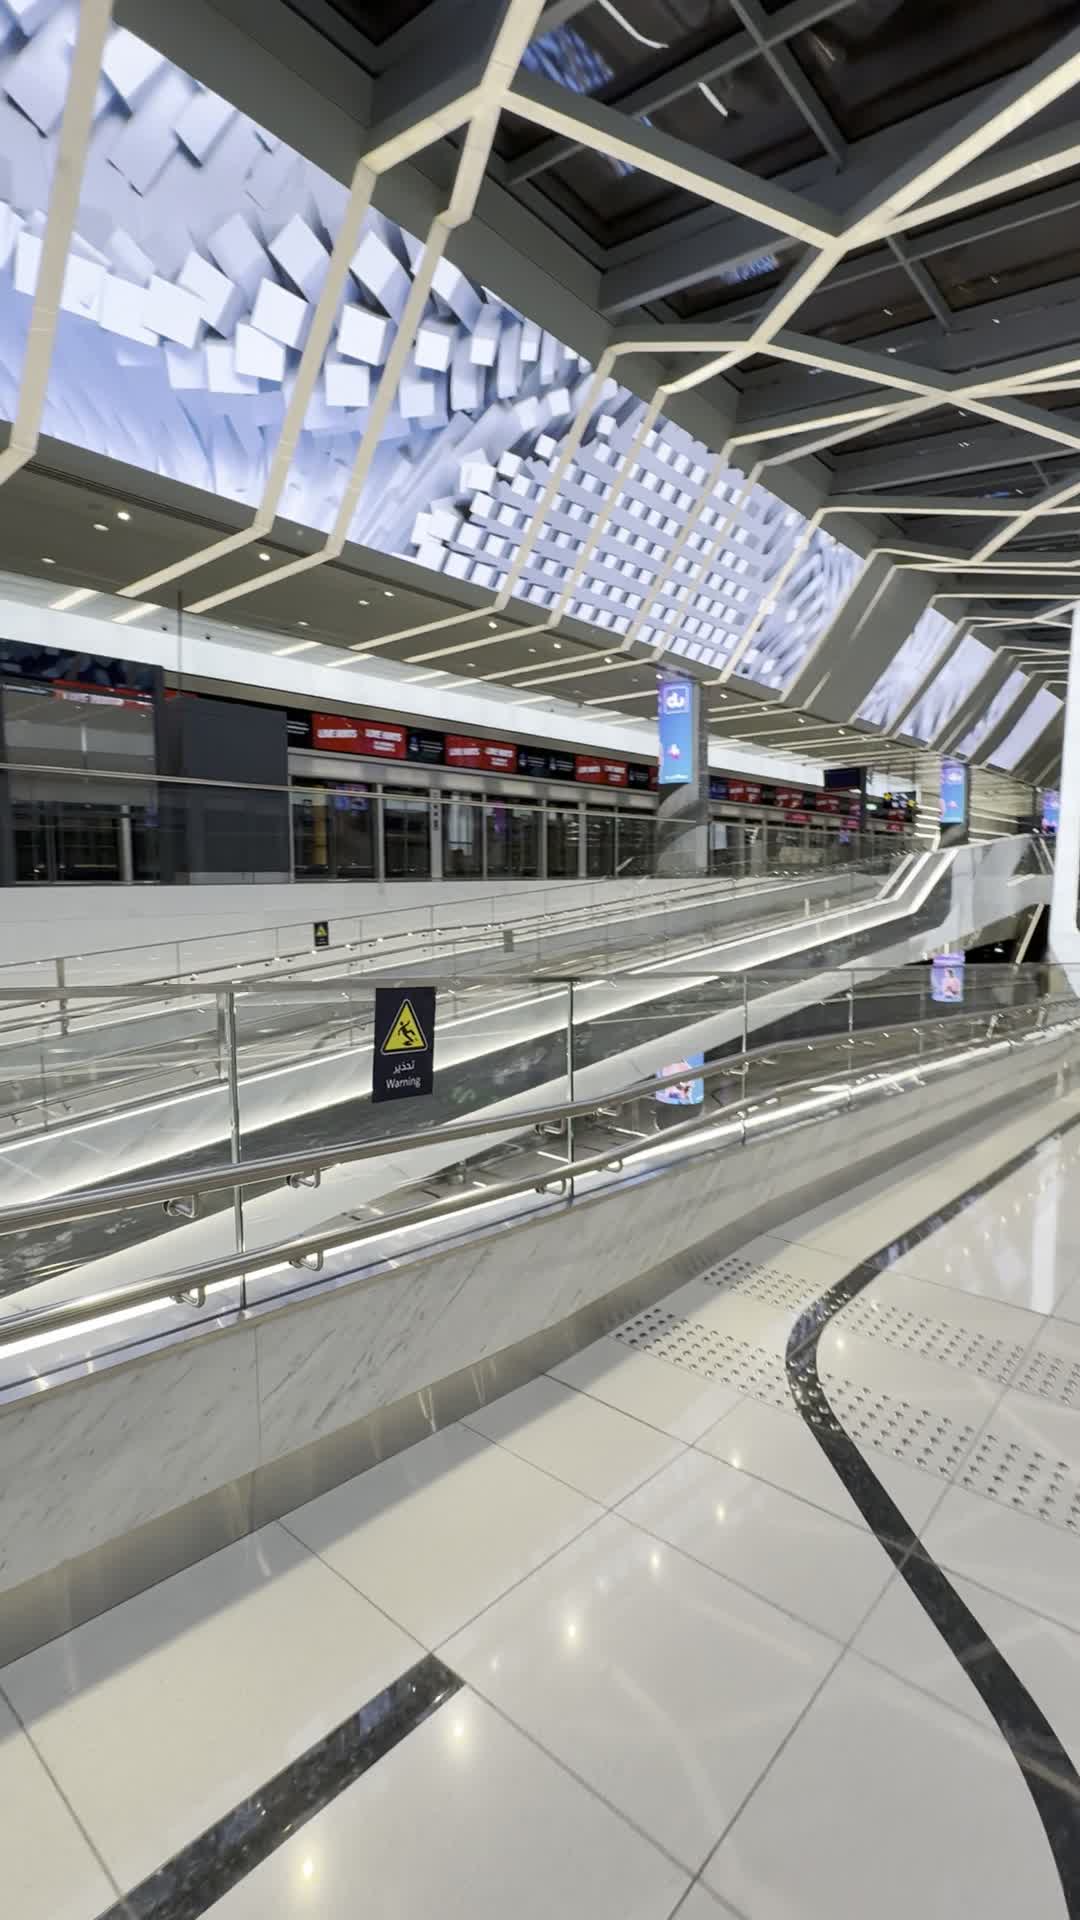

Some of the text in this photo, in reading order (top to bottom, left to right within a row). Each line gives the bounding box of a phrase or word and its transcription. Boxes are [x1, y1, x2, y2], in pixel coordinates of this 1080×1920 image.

[667, 692, 685, 708] du
[392, 1059, 415, 1075] تحذير
[385, 1076, 421, 1089] Warning
